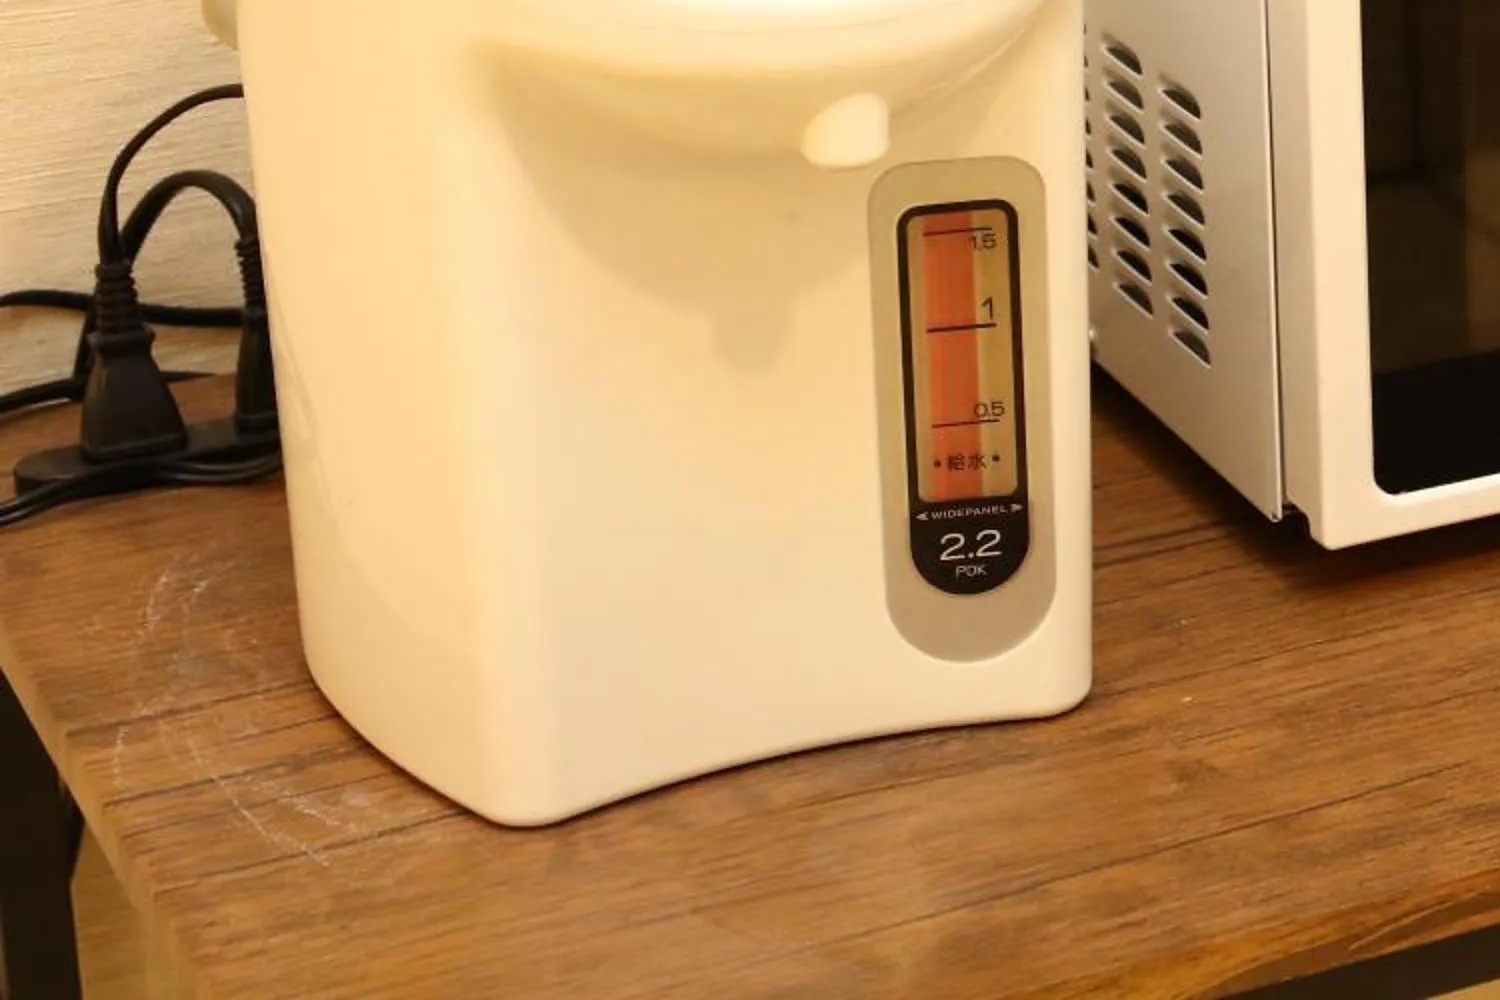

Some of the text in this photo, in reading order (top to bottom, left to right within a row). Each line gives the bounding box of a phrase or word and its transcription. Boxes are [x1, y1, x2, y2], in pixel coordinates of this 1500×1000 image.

[981, 295, 993, 321] 1
[940, 529, 1002, 561] 2.2
[955, 564, 989, 579] PDK
